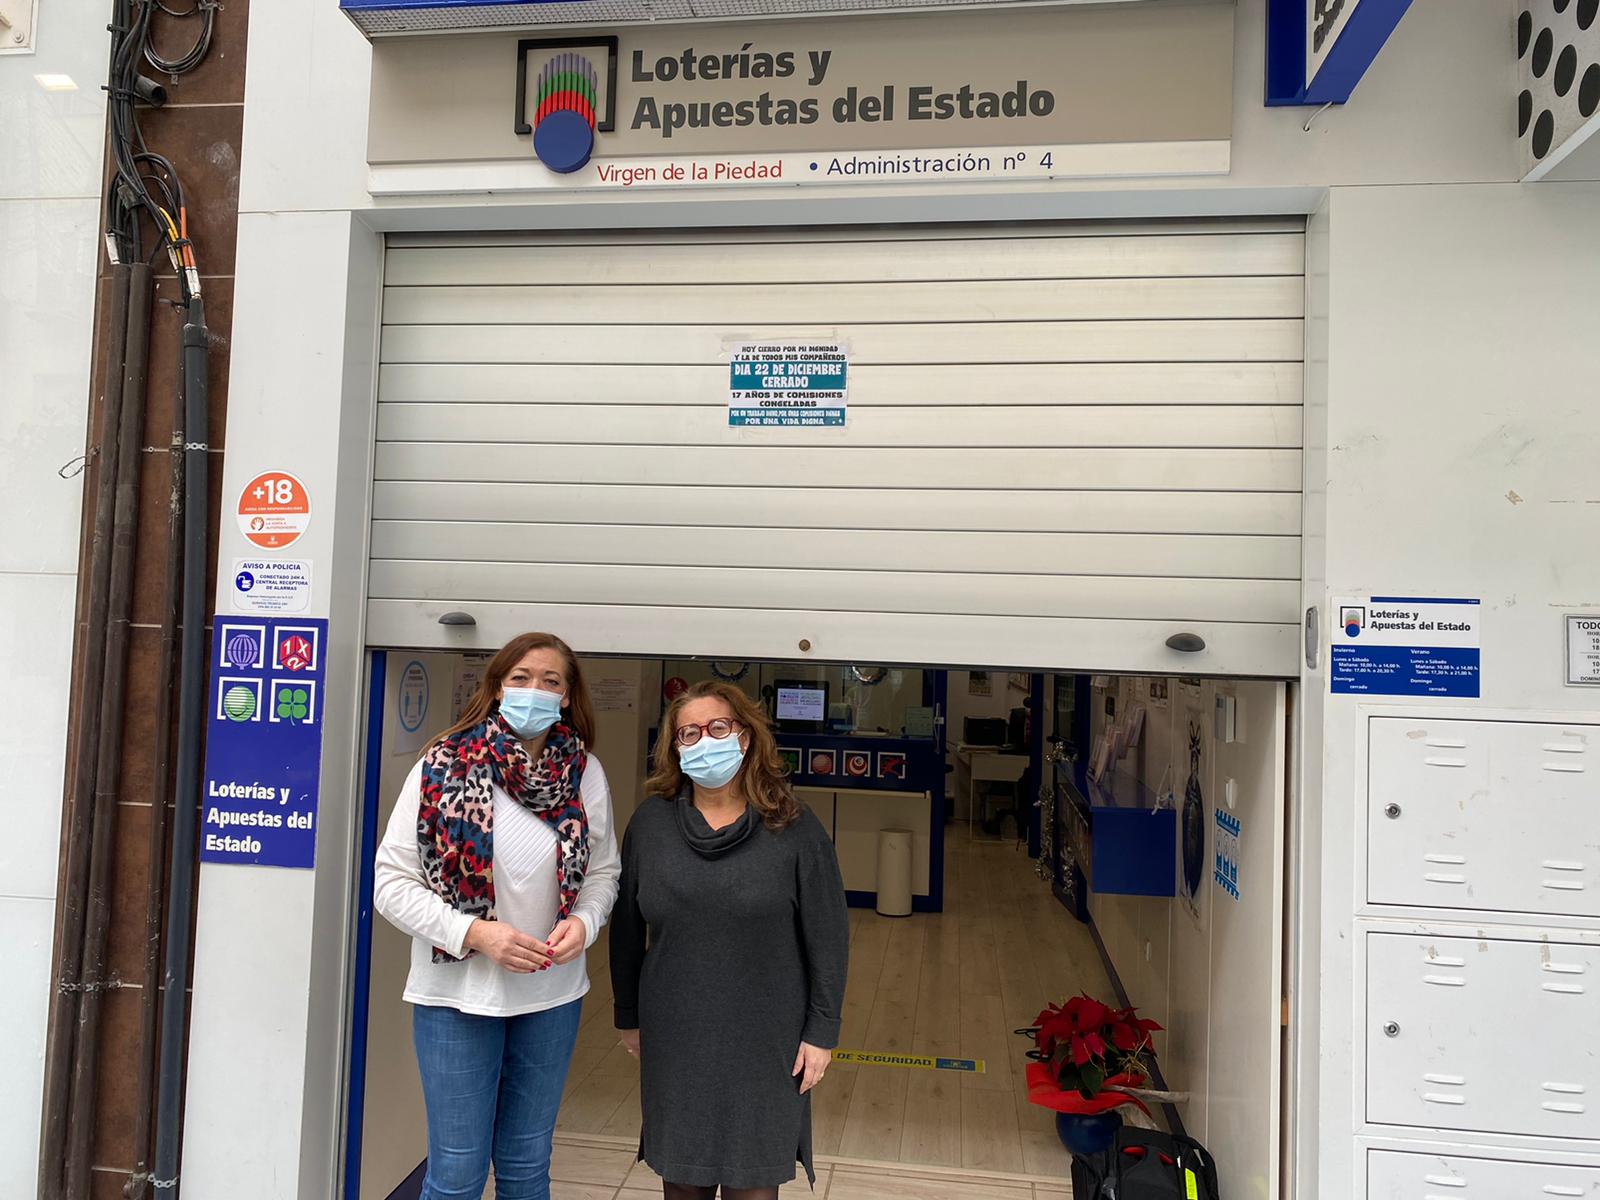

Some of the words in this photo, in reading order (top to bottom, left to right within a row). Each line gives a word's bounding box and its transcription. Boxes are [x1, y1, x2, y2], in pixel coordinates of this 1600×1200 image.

[631, 43, 796, 83] Loterías
[807, 49, 832, 86] y
[631, 92, 819, 138] Apuestas
[832, 85, 894, 123] del
[907, 80, 1056, 120] Estado
[598, 163, 657, 186] Virgen
[662, 161, 686, 182] de
[691, 161, 708, 181] la
[714, 160, 783, 180] Piedad
[826, 153, 991, 176] Administración
[1039, 152, 1054, 170] 4
[734, 364, 751, 376] DIA
[754, 364, 769, 376] 22
[772, 364, 785, 376] DE
[788, 364, 842, 376] DICIEMBRE
[762, 376, 809, 388] CERRADO
[253, 479, 293, 504] +18
[1370, 610, 1410, 619] Loterías
[1412, 612, 1419, 621] y
[1370, 621, 1416, 630] Apuestas
[1419, 622, 1434, 630] del
[1437, 623, 1471, 631] Estado
[209, 780, 275, 800] Loterías
[280, 788, 290, 805] y
[207, 808, 282, 828] Apuestas
[287, 811, 313, 829] del
[205, 834, 262, 853] Estado
[857, 1054, 932, 1066] SEGURIDAD
